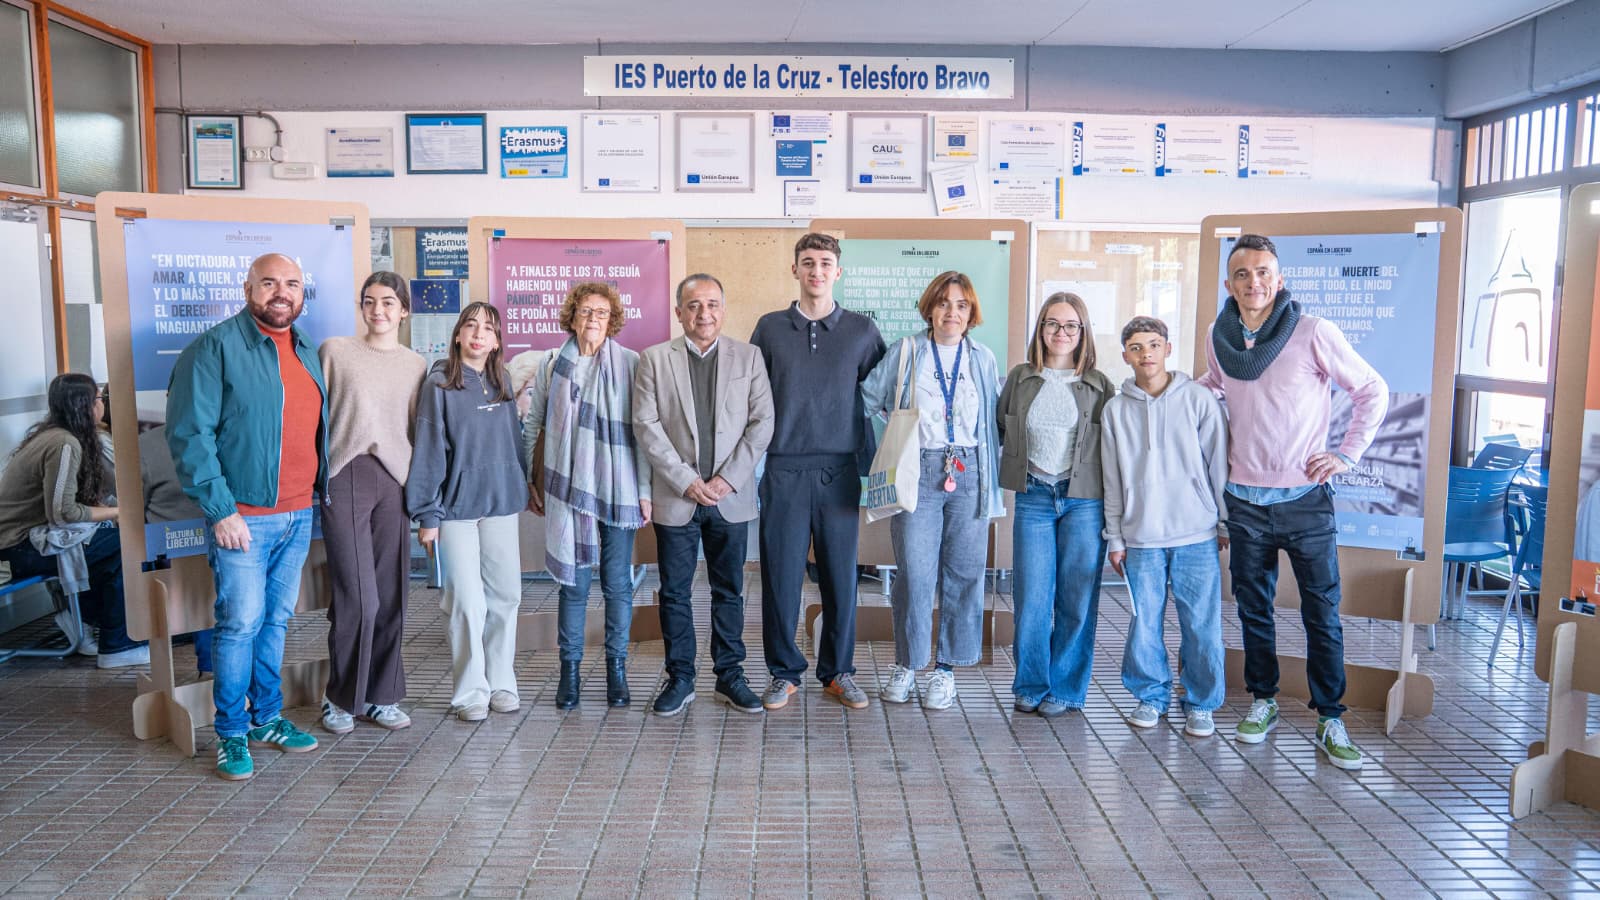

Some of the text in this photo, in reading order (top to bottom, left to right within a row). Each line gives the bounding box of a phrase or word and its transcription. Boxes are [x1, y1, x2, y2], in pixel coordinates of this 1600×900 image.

[615, 63, 647, 89] IES
[653, 63, 717, 90] Puerto
[723, 63, 747, 89] de
[753, 63, 770, 89] la
[777, 63, 821, 89] Cruz
[838, 64, 929, 90] Telesforo
[935, 65, 990, 90] Bravo
[507, 136, 563, 146] Erasmus+
[426, 238, 468, 247] Erasmus
[175, 255, 236, 269] DICTADURA
[239, 255, 252, 269] TE
[520, 266, 557, 277] FINALES
[559, 266, 571, 277] DE
[574, 266, 591, 277] LOS
[593, 266, 606, 279] 70,
[608, 264, 641, 277] SEGUÍA
[858, 267, 890, 276] PRIMERA
[891, 267, 905, 276] VEZ
[906, 267, 921, 277] QUE
[1281, 266, 1399, 277] CELEBRAR LA MUERTE DEL
[152, 271, 185, 284] AMAR
[188, 271, 195, 284] A
[198, 271, 235, 286] QUIEN,
[844, 278, 897, 288] AYUNTAMIENTO
[898, 278, 909, 288] DE
[506, 280, 553, 291] HABIENDO
[554, 280, 568, 291] UN
[1291, 279, 1320, 291] SOBRE
[1350, 279, 1361, 291] EL
[1364, 279, 1392, 291] INICIO
[153, 284, 246, 300] Y LO MÁS TERRIB
[542, 294, 555, 305] EN
[1324, 293, 1343, 305] QUE
[1344, 293, 1362, 304] FUE
[1364, 293, 1376, 304] EL
[154, 304, 232, 317] EL DERECHO A
[507, 308, 519, 320] SE
[520, 306, 548, 320] PODÍA
[1308, 304, 1374, 318] CONSTITUCIÓN
[1375, 306, 1395, 319] QUE
[507, 322, 519, 334] EN
[522, 322, 534, 334] LA
[166, 530, 195, 540] CULTURA
[166, 535, 205, 549] LIBERTAD
